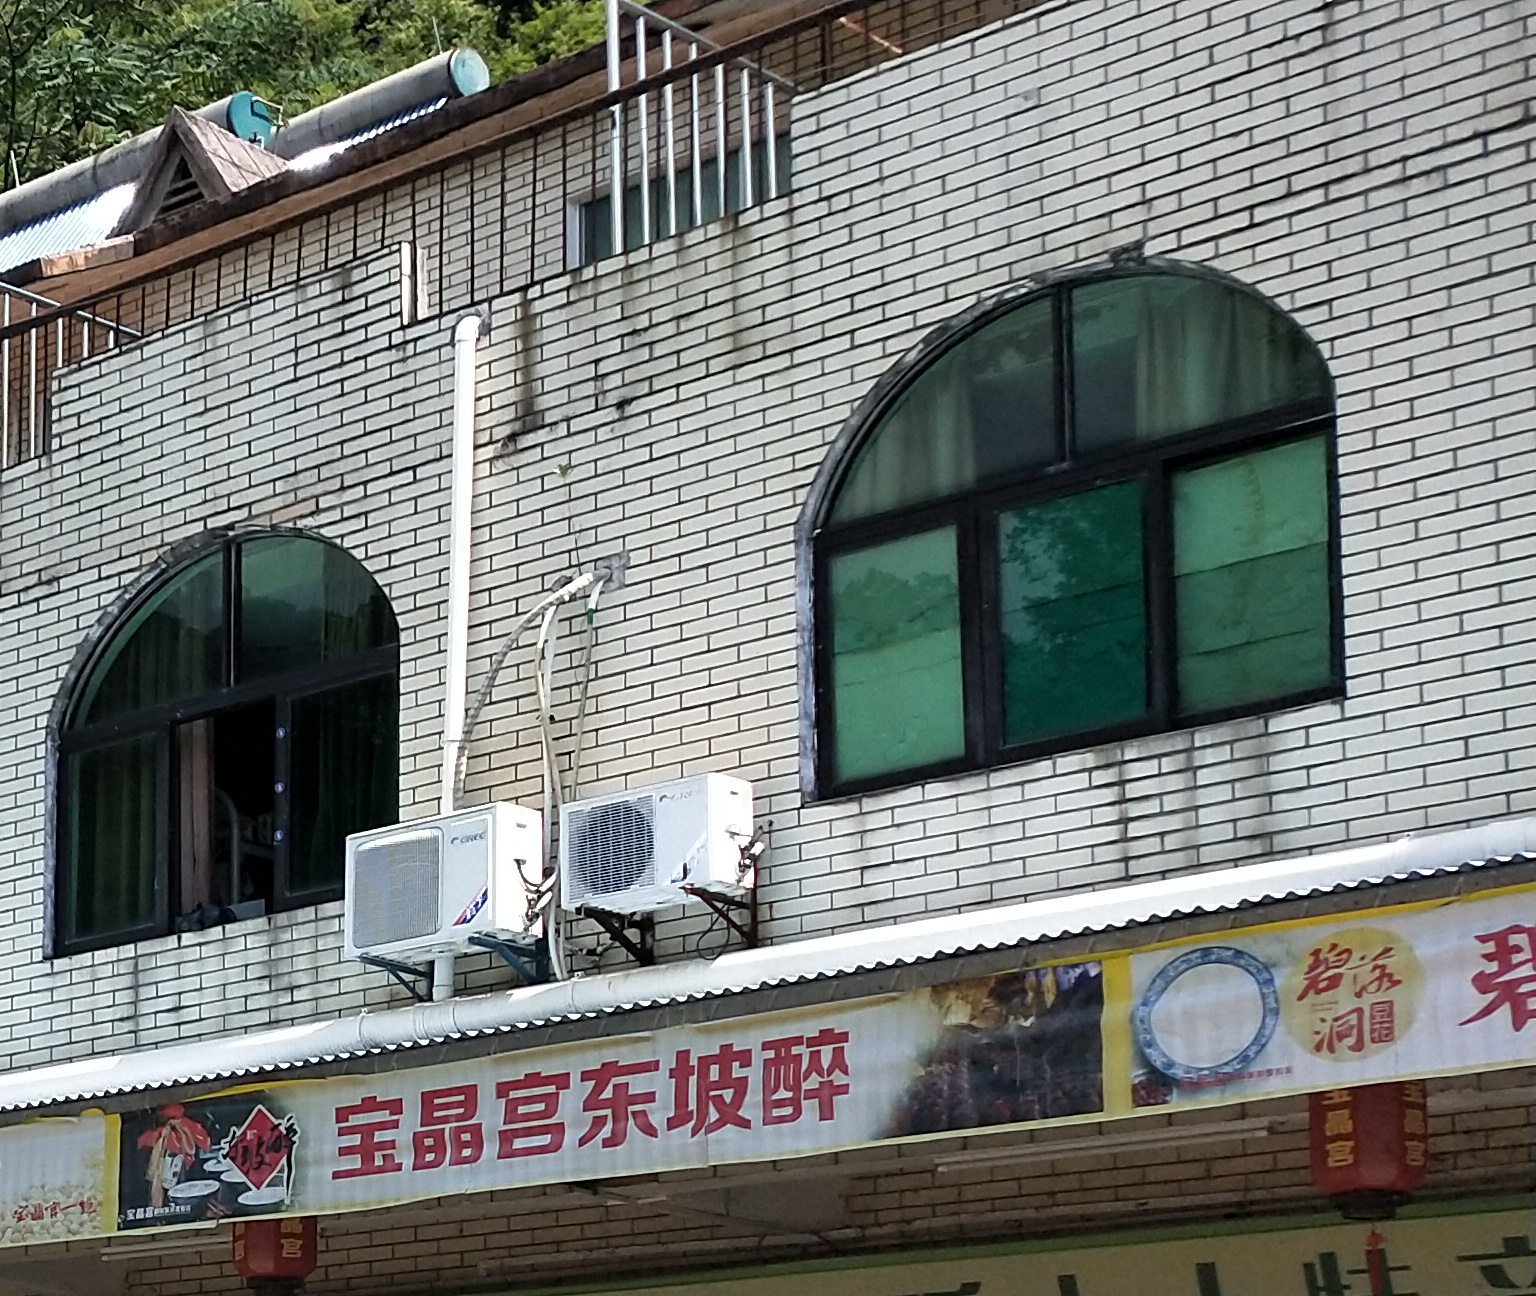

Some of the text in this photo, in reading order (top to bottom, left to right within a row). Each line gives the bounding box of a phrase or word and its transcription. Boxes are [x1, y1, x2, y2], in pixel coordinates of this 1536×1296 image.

[331, 1027, 852, 1183] 宝晶宫东坡醉
